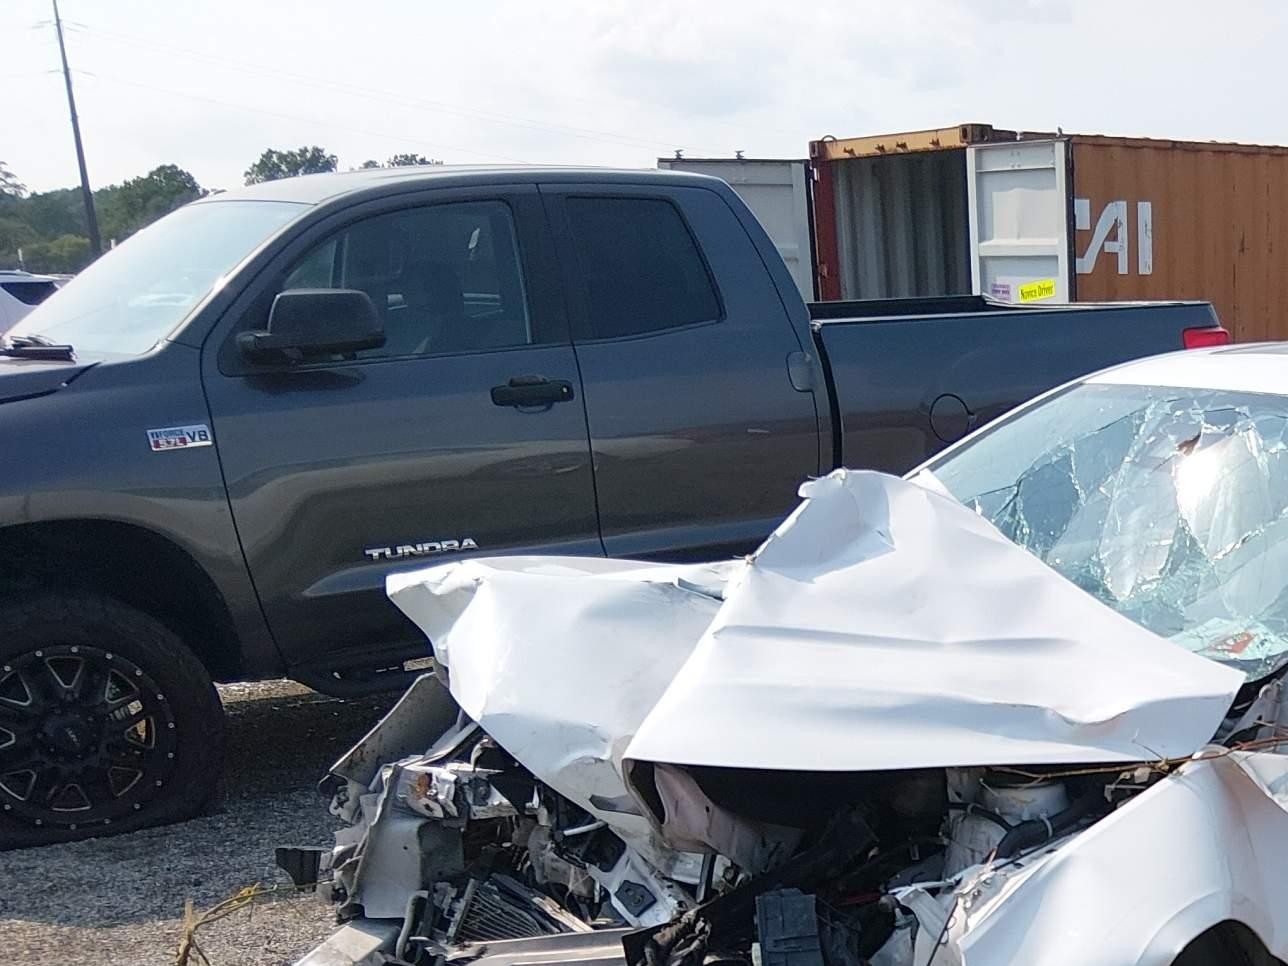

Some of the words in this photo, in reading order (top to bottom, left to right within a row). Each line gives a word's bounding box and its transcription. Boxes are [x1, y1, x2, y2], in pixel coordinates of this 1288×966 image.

[1038, 283, 1053, 297] Driver
[186, 429, 209, 443] V8
[364, 537, 480, 561] TUNDRA
